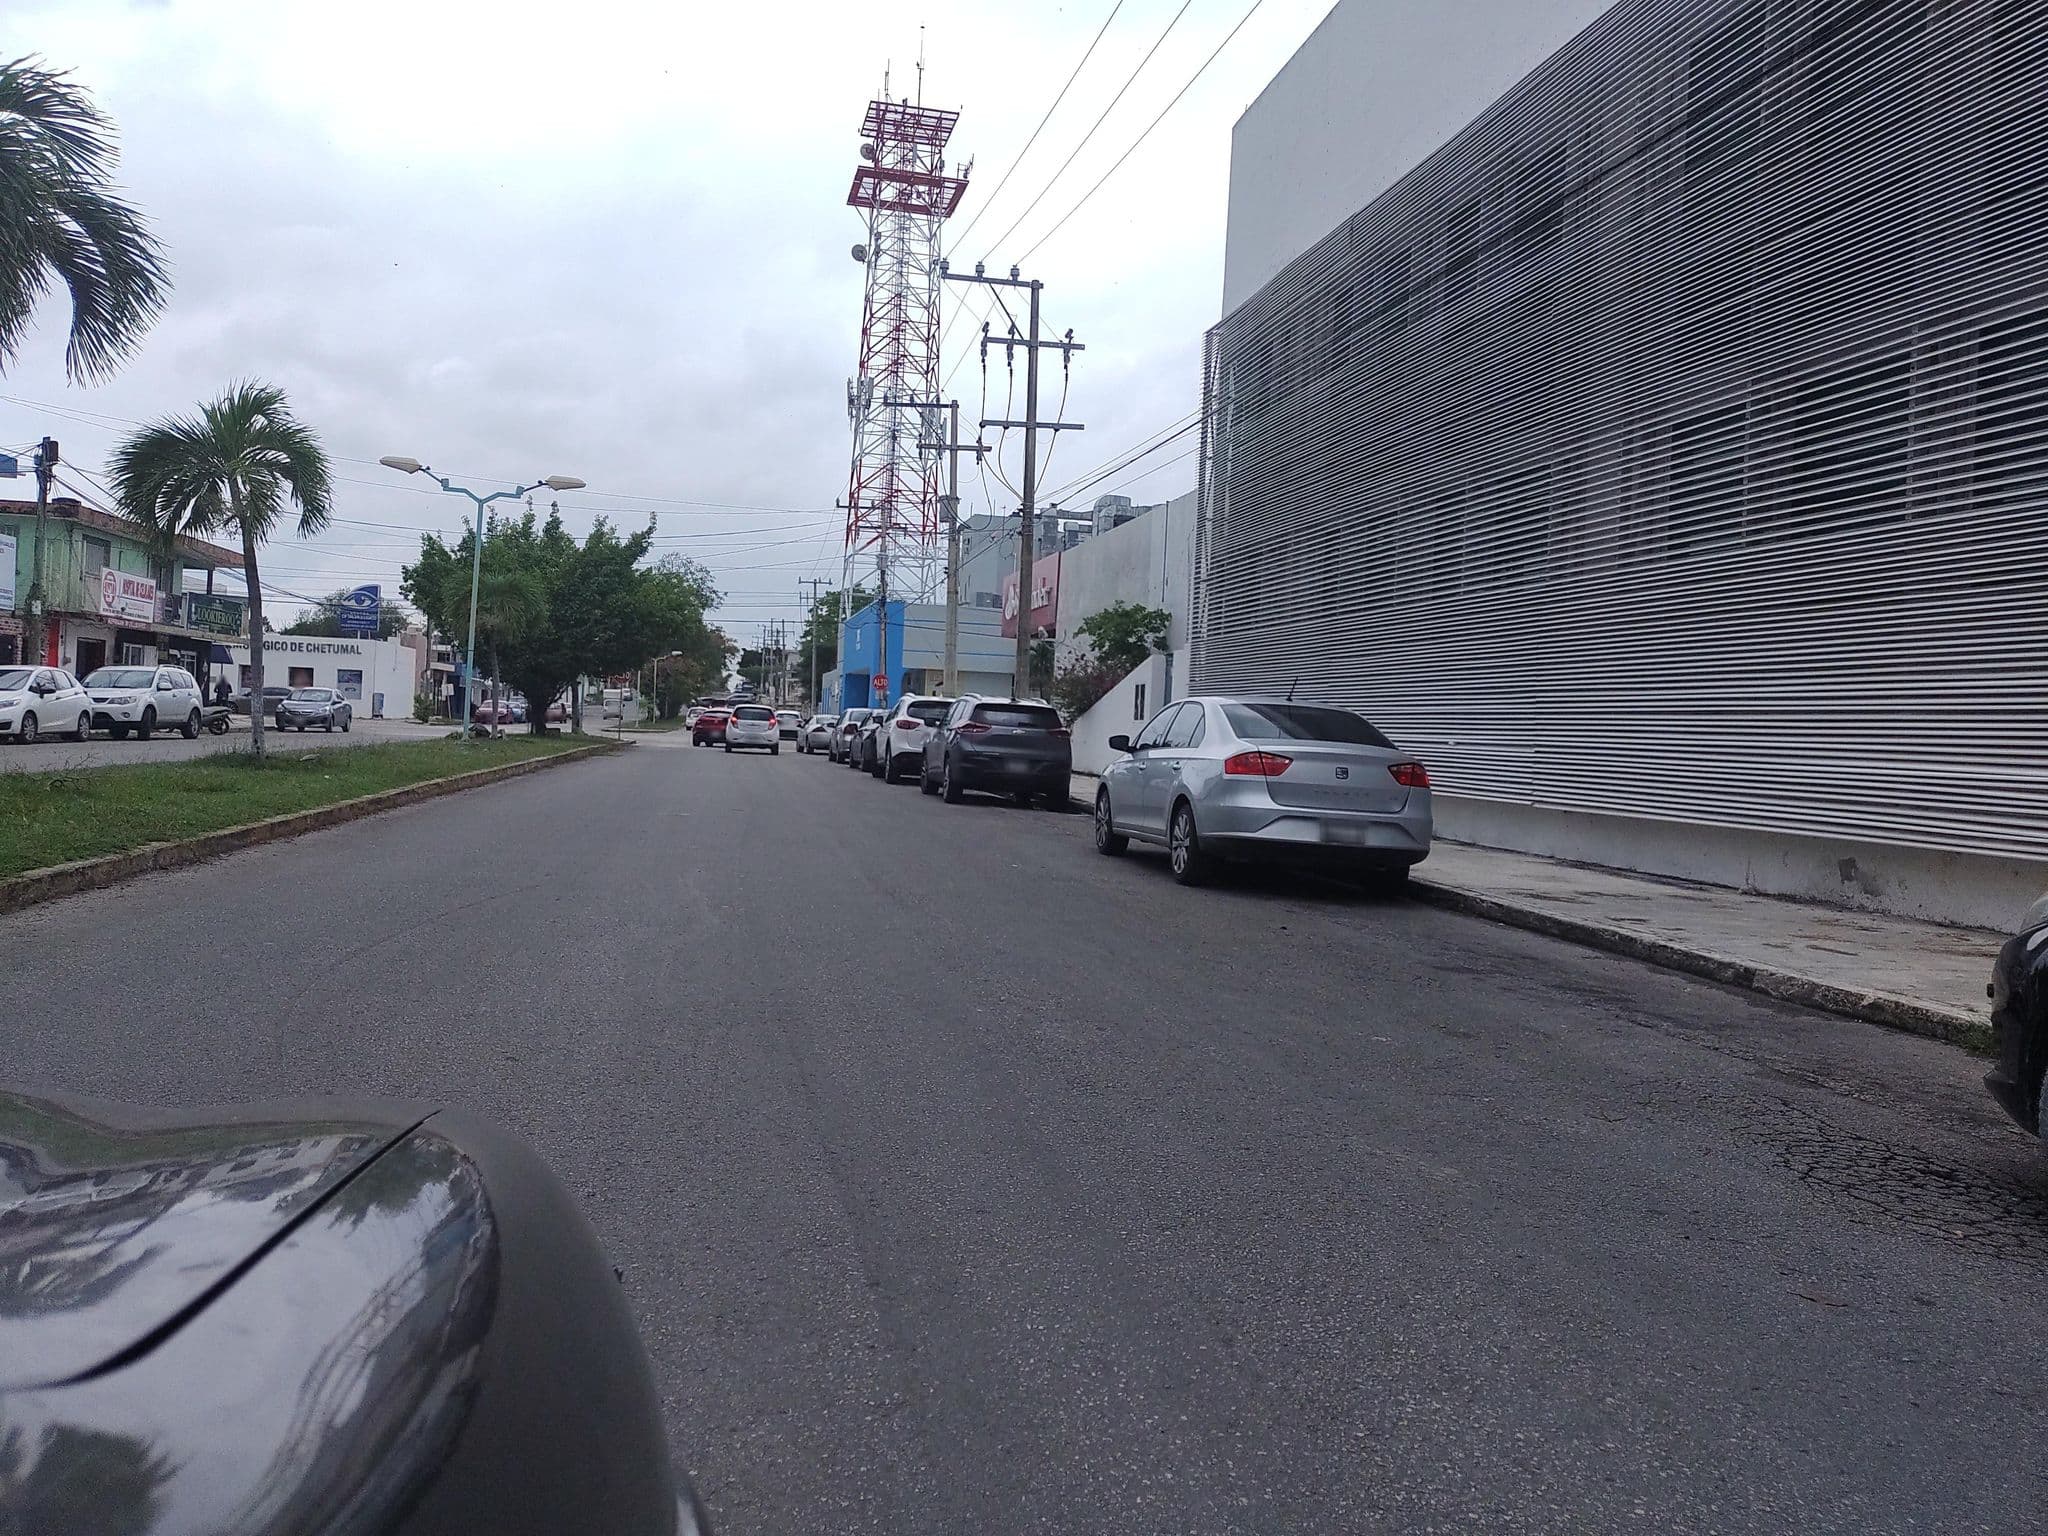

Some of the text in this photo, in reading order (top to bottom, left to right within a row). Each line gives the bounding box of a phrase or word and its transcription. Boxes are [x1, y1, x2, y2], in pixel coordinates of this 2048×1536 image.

[290, 641, 305, 652] DE
[306, 642, 362, 655] CHETUMAL
[873, 678, 888, 687] ALTO
